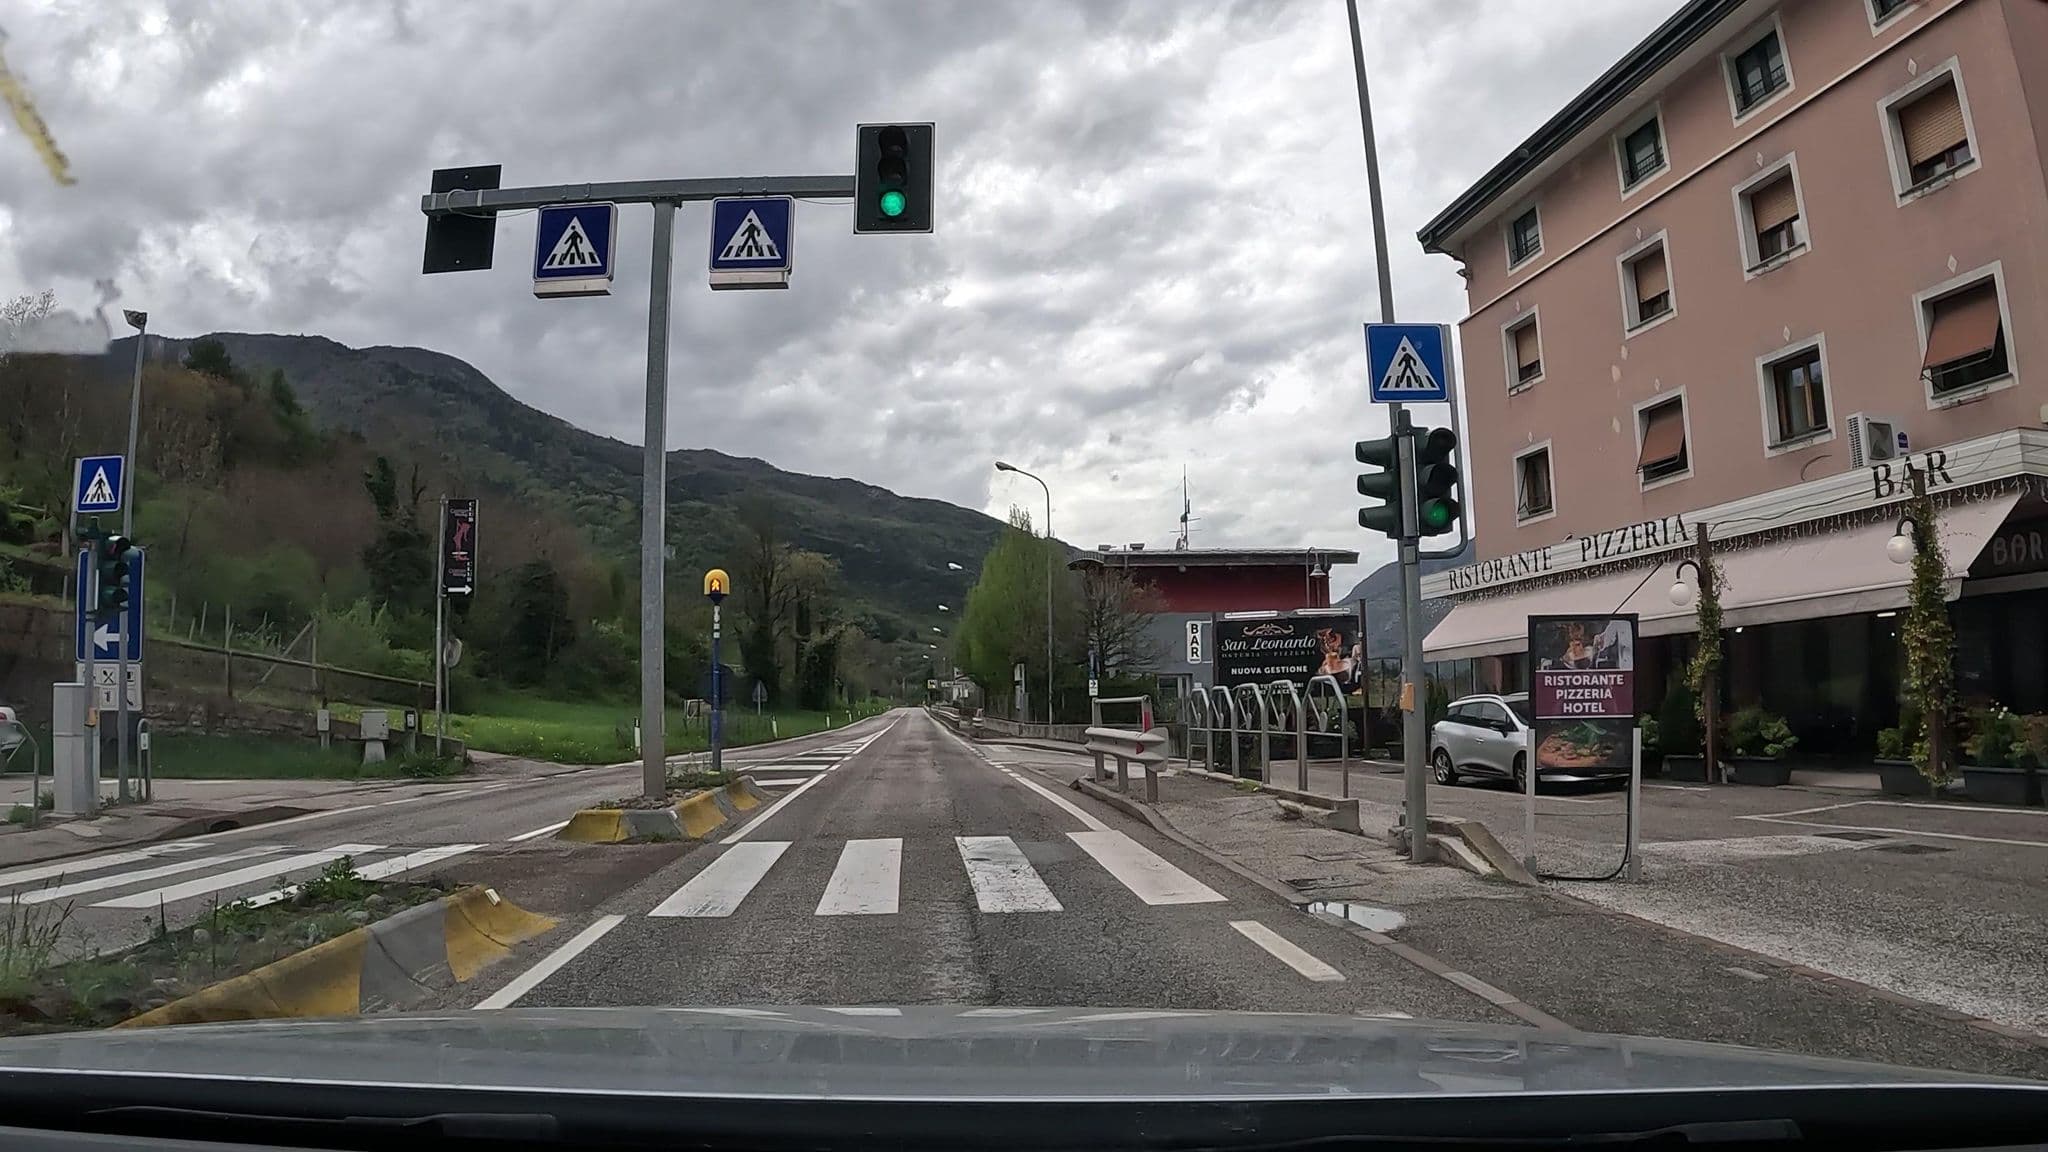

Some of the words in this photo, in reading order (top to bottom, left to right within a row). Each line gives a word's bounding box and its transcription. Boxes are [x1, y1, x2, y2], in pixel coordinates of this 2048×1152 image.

[1872, 450, 1953, 500] BAR
[1449, 546, 1552, 591] RISTORANTE
[1580, 514, 1689, 562] PIZZERIA
[1992, 531, 2044, 565] BAR
[1191, 624, 1200, 657] BAR
[1221, 639, 1249, 652] San
[1250, 635, 1316, 650] Leonardo
[1231, 667, 1262, 675] NUOVA
[1264, 665, 1308, 674] GESTIONE
[1544, 674, 1624, 687] RISTORANTE
[1556, 688, 1613, 700] PIZZERIA
[1563, 702, 1606, 713] HOTEL
